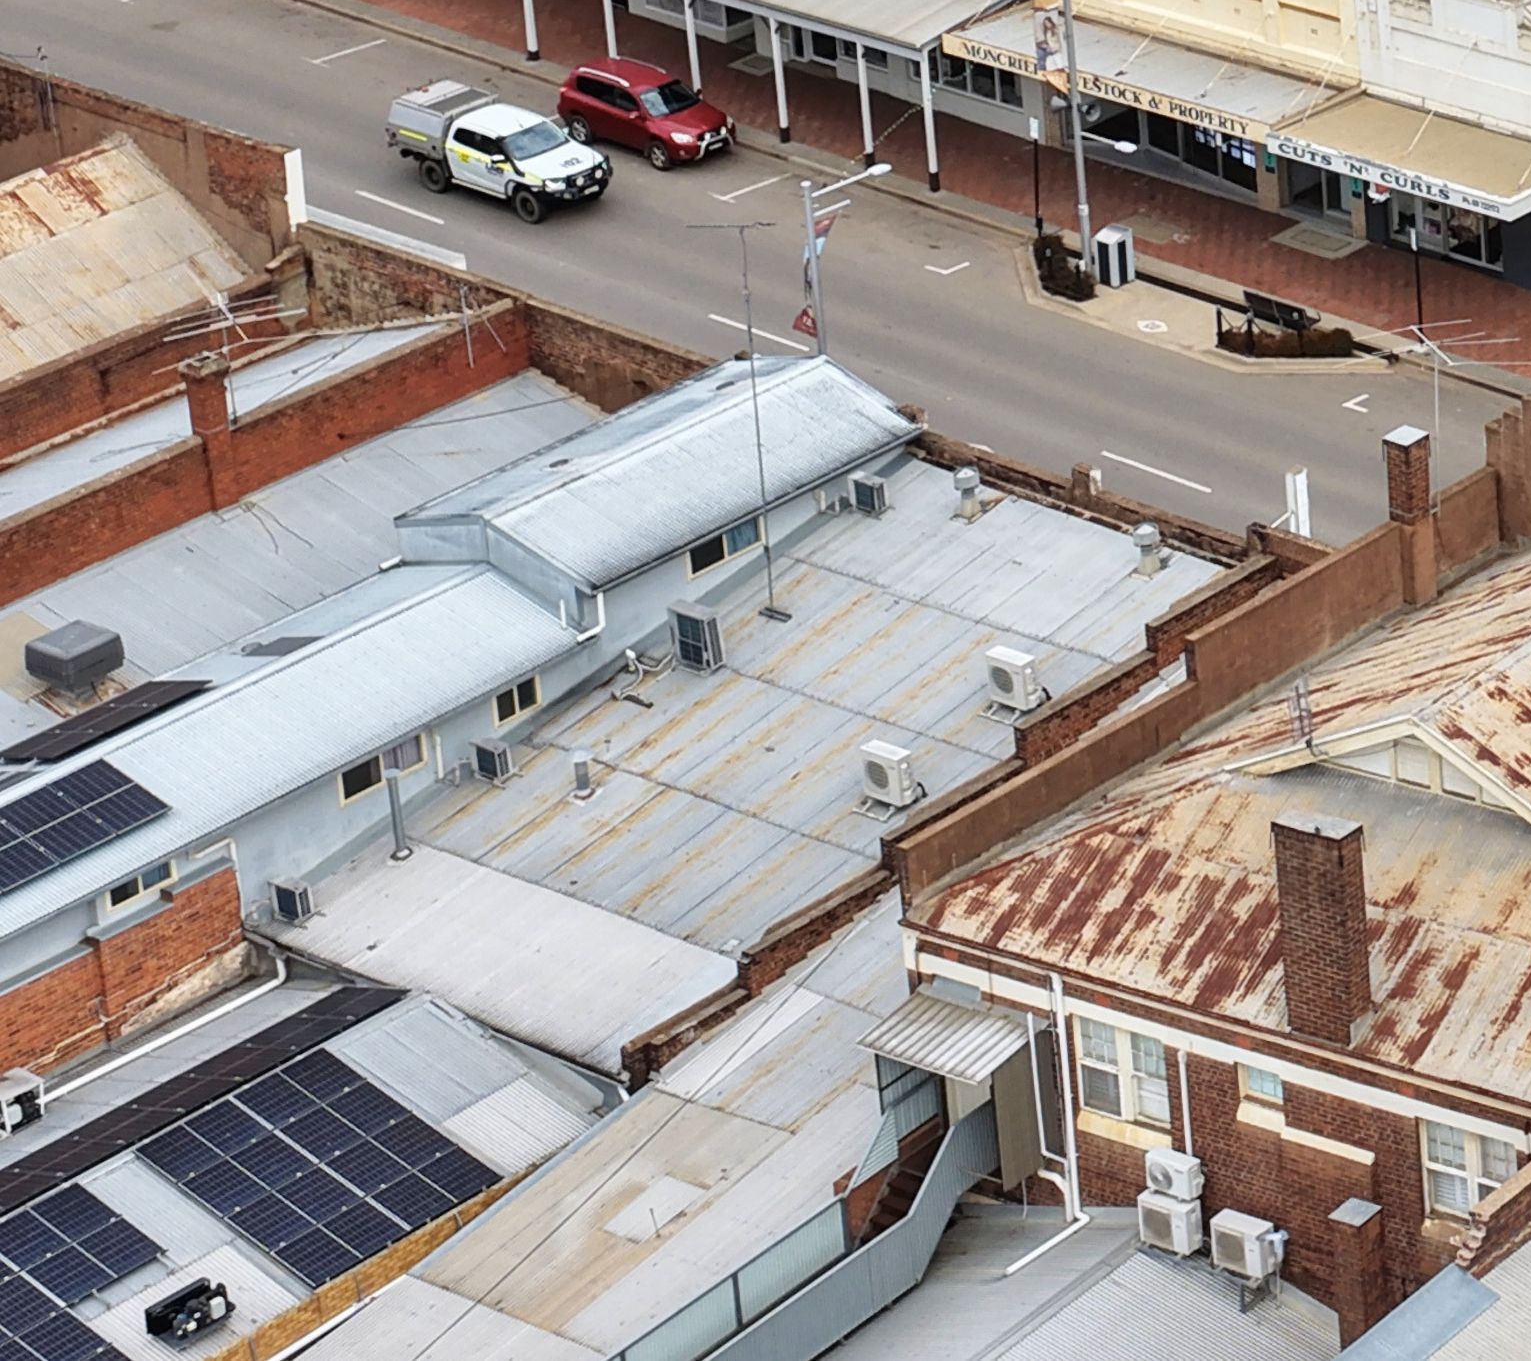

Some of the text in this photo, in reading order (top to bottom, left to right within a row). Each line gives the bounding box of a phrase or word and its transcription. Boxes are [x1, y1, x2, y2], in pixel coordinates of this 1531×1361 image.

[1169, 101, 1250, 135] PROPERTY
[1278, 142, 1333, 167] CUTS
[1380, 171, 1450, 201] CURLS
